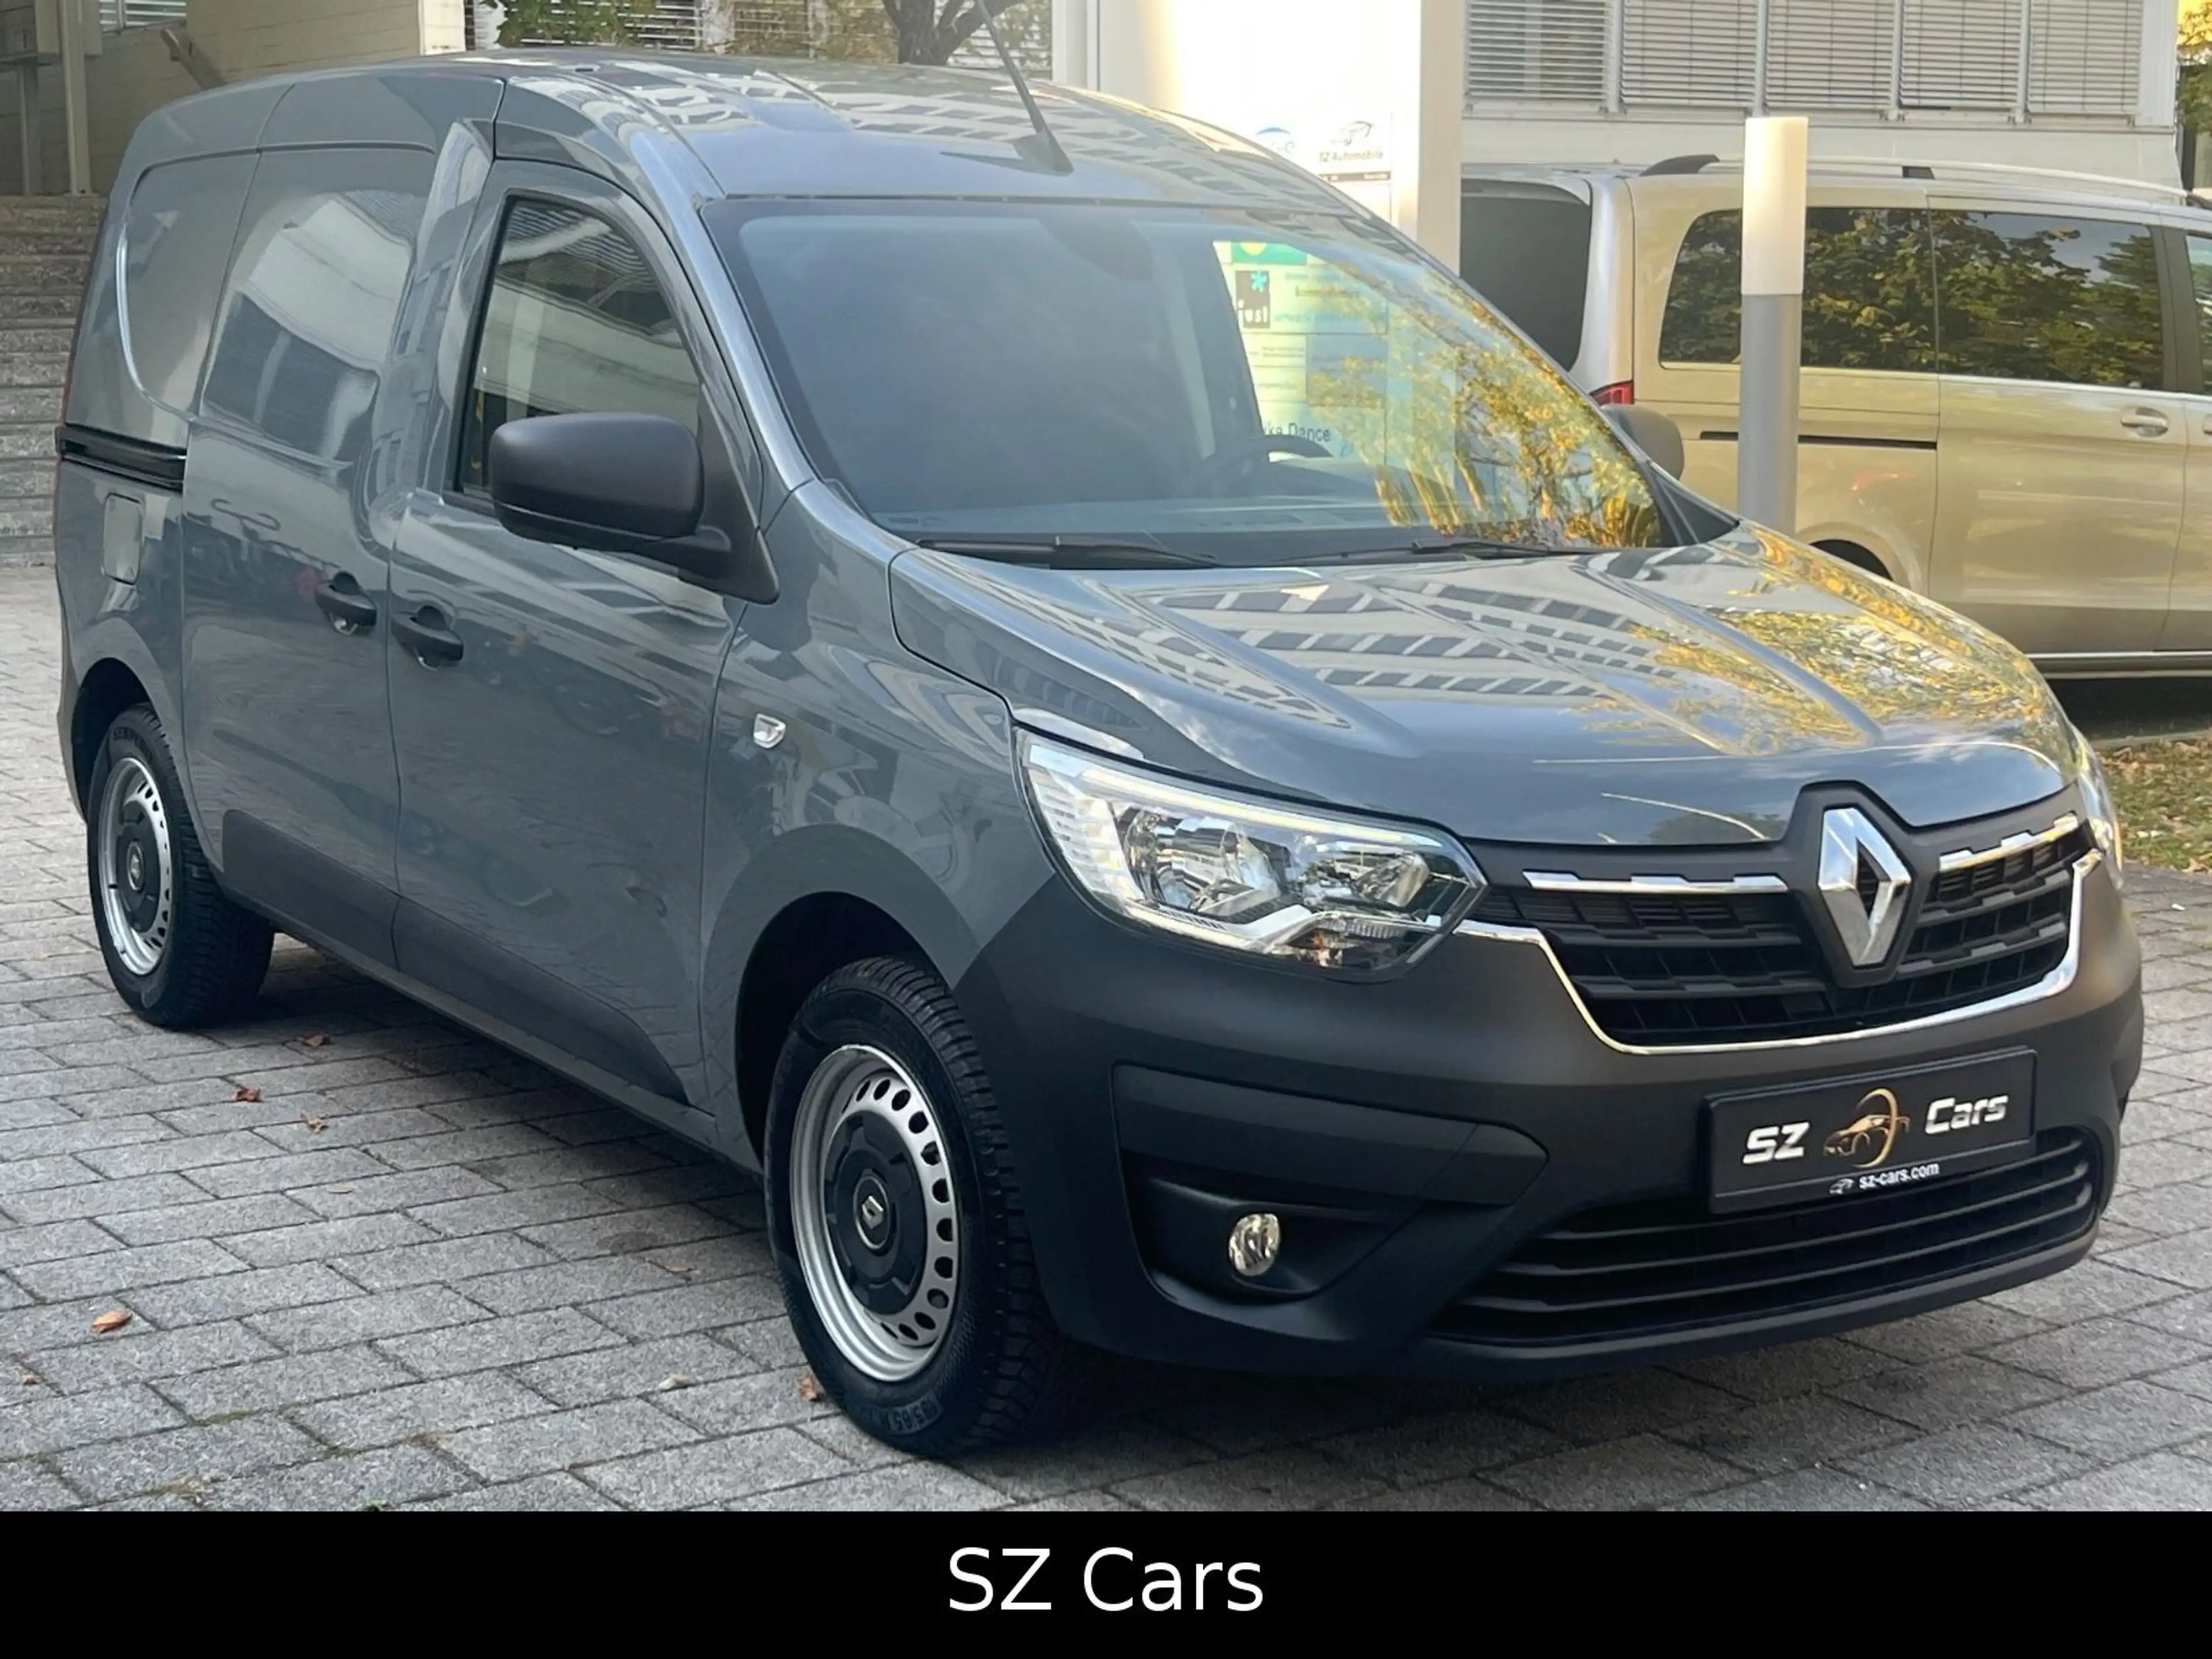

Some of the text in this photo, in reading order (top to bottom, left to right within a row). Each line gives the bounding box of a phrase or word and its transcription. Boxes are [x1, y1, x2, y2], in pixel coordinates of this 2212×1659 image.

[1288, 422, 1331, 442] Dance
[1743, 1094, 2009, 1164] SZ Cars
[1858, 1162, 1940, 1190] sz-cars.com
